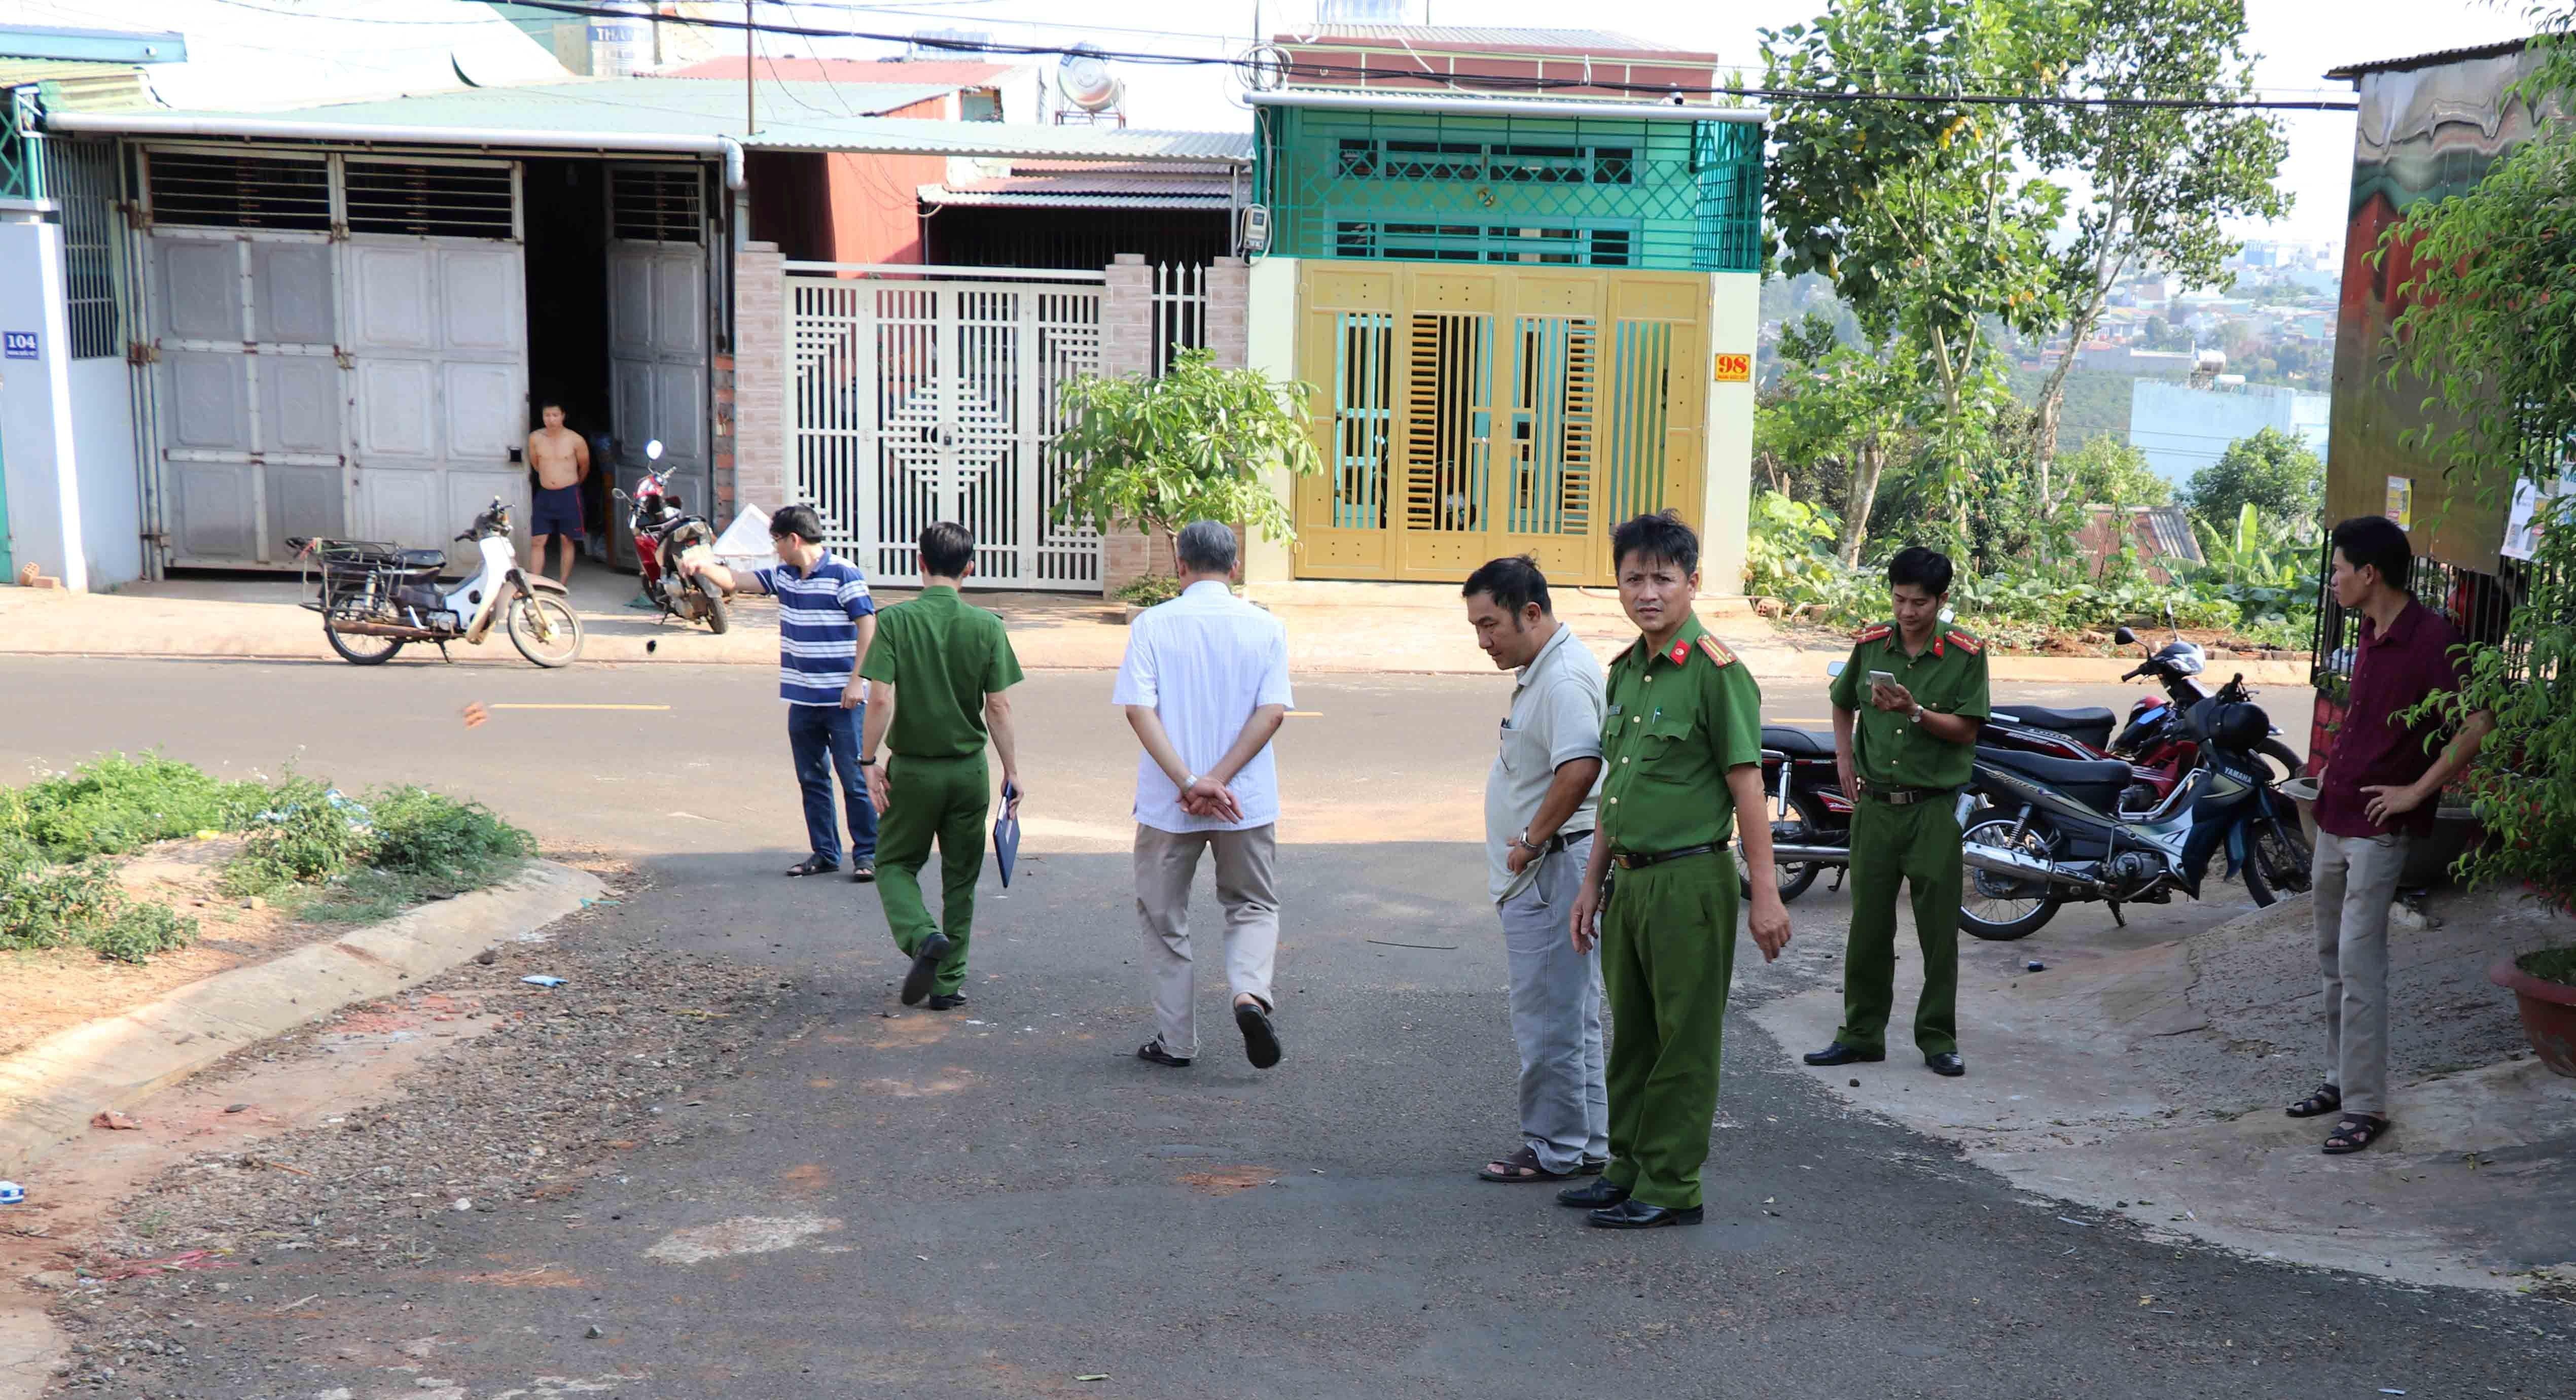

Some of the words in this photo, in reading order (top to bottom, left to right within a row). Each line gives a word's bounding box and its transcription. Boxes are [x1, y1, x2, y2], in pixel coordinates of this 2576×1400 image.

[8, 334, 35, 348] 104
[1719, 356, 1746, 373] 98
[2224, 766, 2251, 784] YAMAHA
